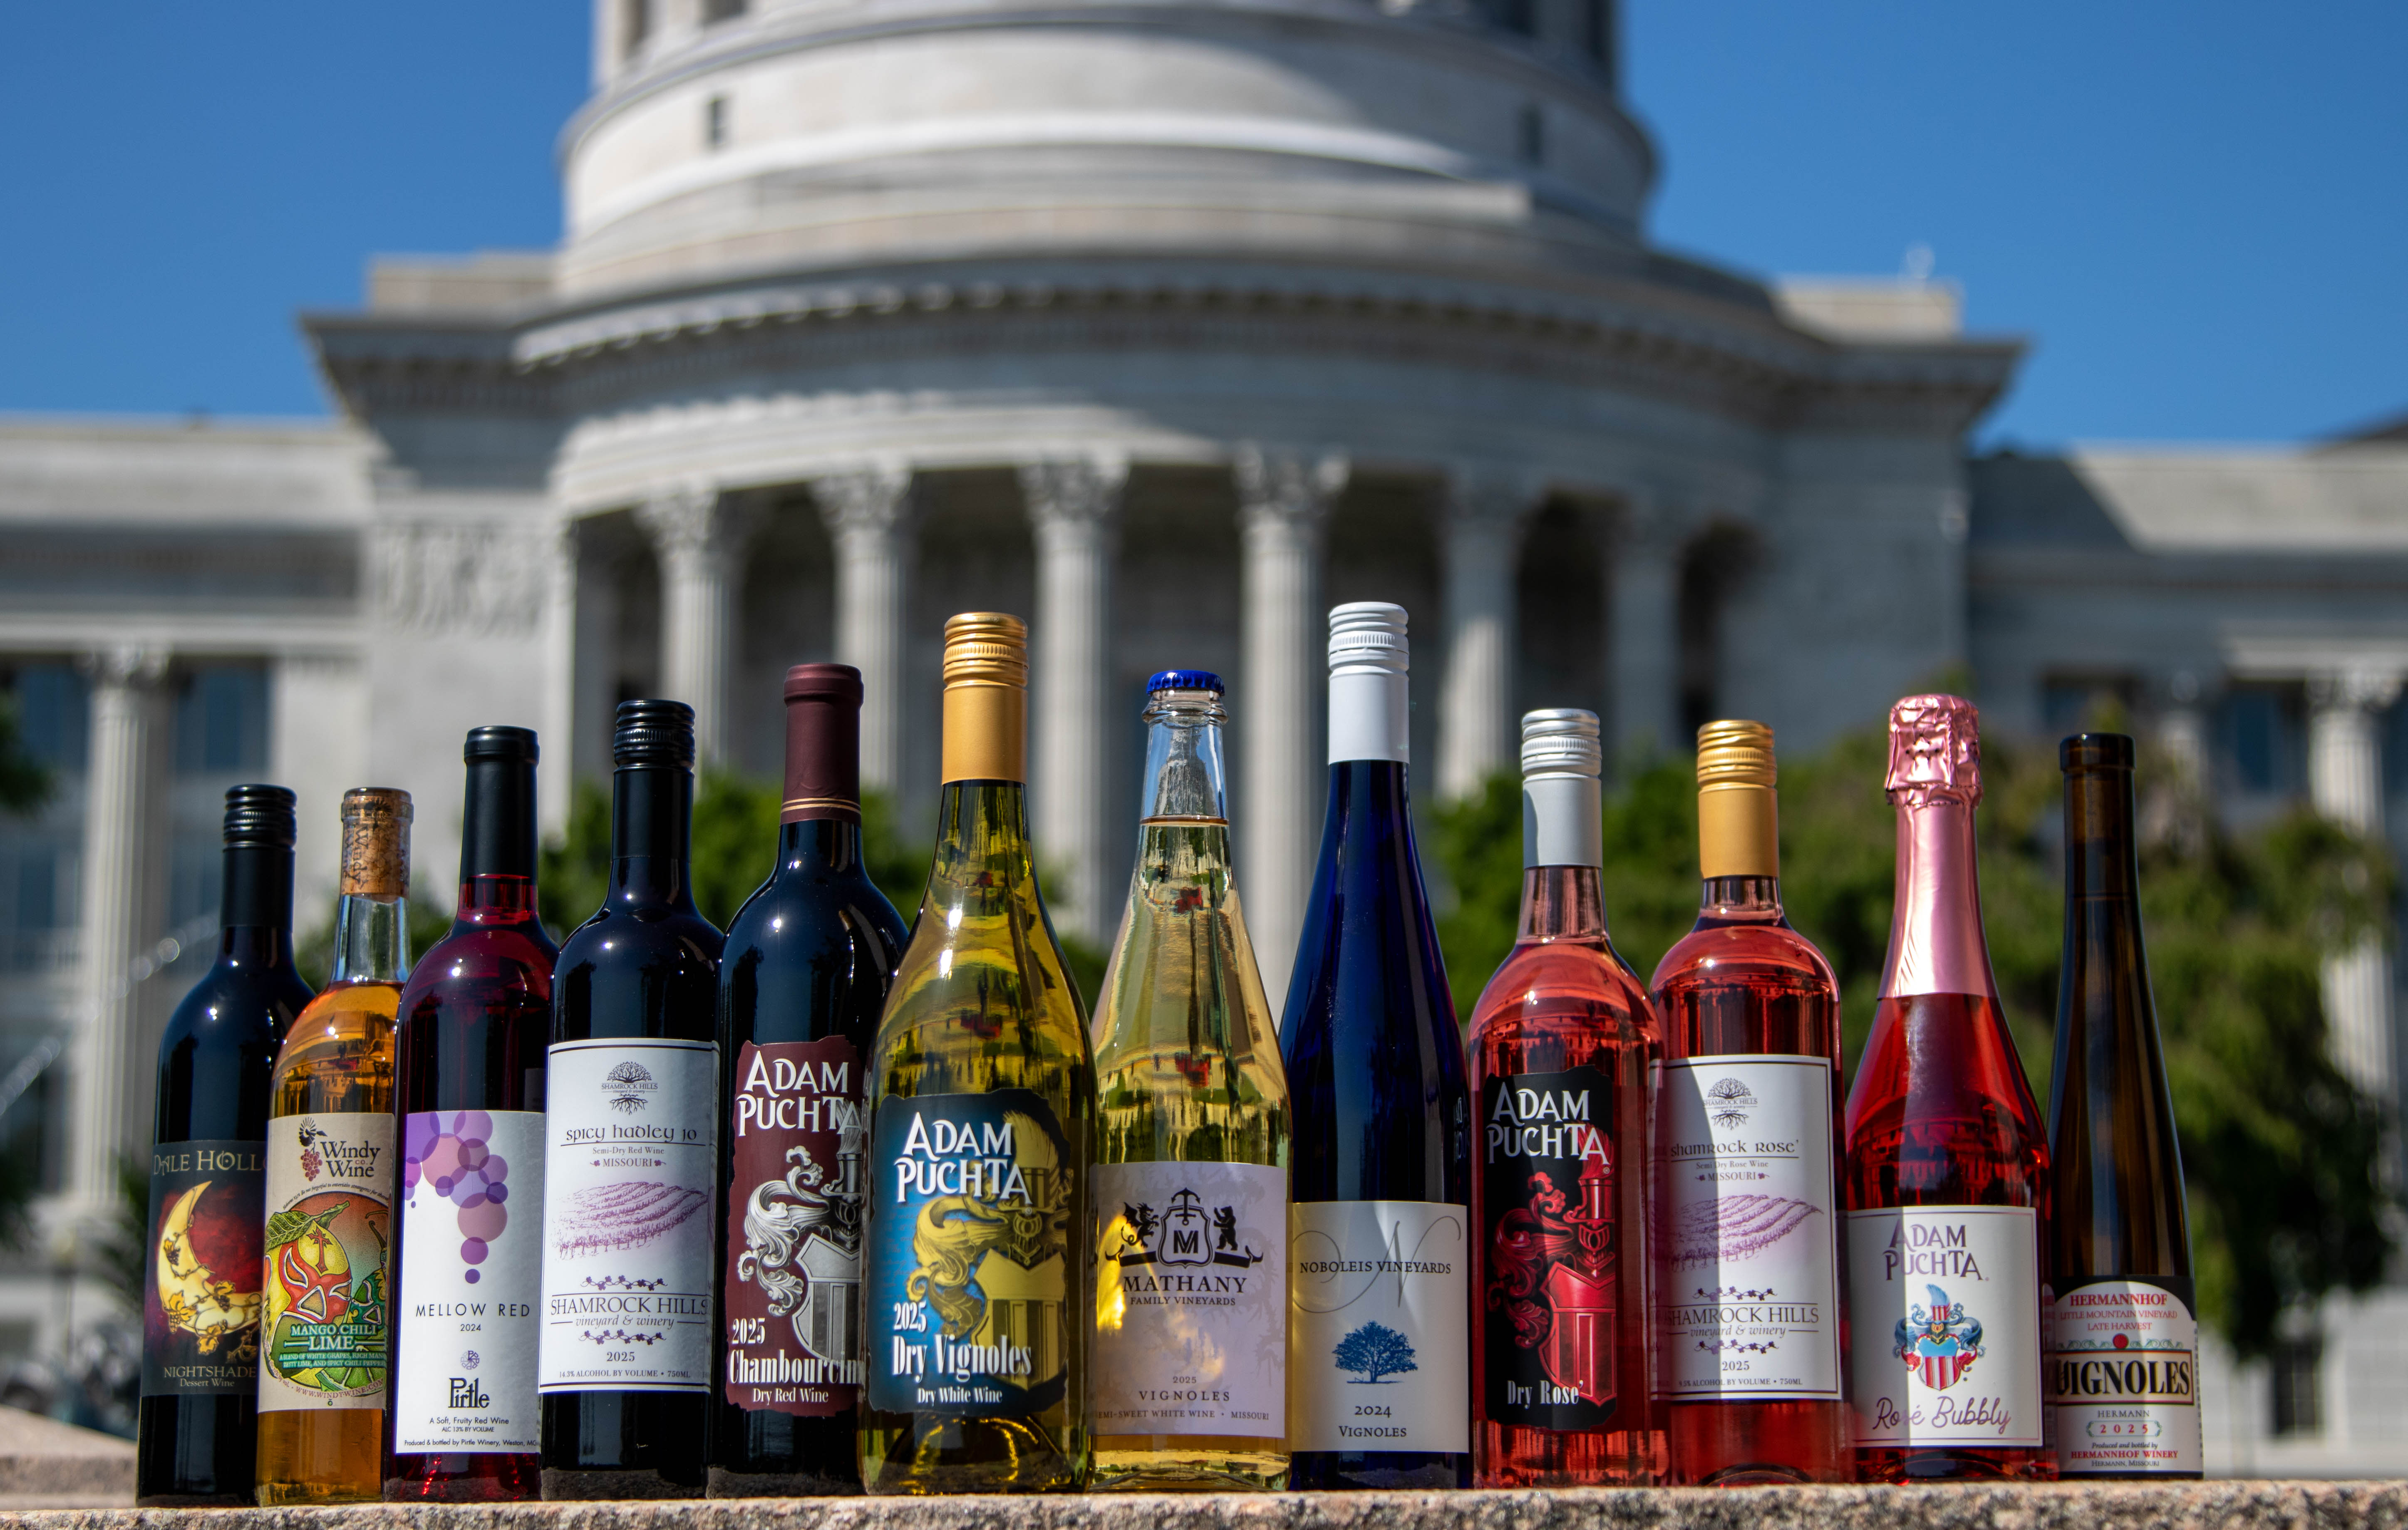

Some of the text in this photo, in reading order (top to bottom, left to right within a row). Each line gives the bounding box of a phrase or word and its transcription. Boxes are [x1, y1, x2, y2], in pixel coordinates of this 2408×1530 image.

[744, 1050, 849, 1098] ADAM
[1492, 1082, 1590, 1127] ADAM
[736, 1094, 863, 1136] PUCHTA
[566, 1128, 605, 1143] spicy
[613, 1124, 674, 1142] hadley
[903, 1112, 1012, 1161] ADAM
[320, 1140, 381, 1165] Windy
[593, 1146, 626, 1156] Semi-Dry
[645, 1146, 665, 1154] Wine
[1485, 1123, 1611, 1165] PUCHTA
[154, 1150, 266, 1176] DALE HOLL
[326, 1159, 374, 1177] Wine
[603, 1158, 652, 1167] MISSOURI
[1696, 1161, 1712, 1170] Semi
[1716, 1161, 1727, 1170] Dry
[894, 1157, 1033, 1205] PUCHTA
[1708, 1172, 1756, 1182] MISSOURI
[1173, 1230, 1199, 1254] M
[1889, 1218, 1967, 1253] ADAM
[1300, 1261, 1451, 1274] NOBOLEIS VINEYARDS
[1882, 1249, 1984, 1281] PUCHTA
[1123, 1275, 1247, 1293] MATHANY
[551, 1297, 706, 1315] SHAMROCK HILLS
[1131, 1297, 1236, 1305] FAMILY VINEYARDS
[2070, 1293, 2167, 1307] HERMANNHOF
[416, 1303, 530, 1317] MELLOW RED
[894, 1300, 927, 1332] 2025
[1666, 1307, 1819, 1326] SHAMROCK HILLS
[2060, 1310, 2177, 1321] LITTLE MOUNTAIN VINEYARD
[291, 1324, 377, 1336] MANGO CHILI
[576, 1315, 675, 1330] vineyard & winery
[732, 1318, 766, 1344] 2025
[2111, 1322, 2152, 1330] HARVEST
[1690, 1325, 1786, 1339] vineyard & winery
[309, 1336, 354, 1350] LIME
[606, 1352, 635, 1362] 2025
[893, 1333, 1032, 1383] Dry Vignoles
[1722, 1361, 1750, 1371] 2025
[164, 1366, 257, 1378] NIGHTSHADE
[730, 1349, 858, 1384] Chambourcin
[180, 1377, 235, 1386] Dessert Wine
[448, 1378, 490, 1408] Pirtle
[753, 1387, 829, 1405] Dry Red Wine
[918, 1386, 1003, 1406] Dry White Wine
[1138, 1391, 1230, 1401] VIGNOLES
[1507, 1380, 1533, 1410] Dry
[1098, 1410, 1149, 1419] EMI-SWEET
[1230, 1411, 1269, 1420] MISSOURI
[1354, 1405, 1392, 1418] 2024
[1872, 1396, 2011, 1435] Rosé Bubbly
[454, 1417, 472, 1426] Fruity
[452, 1439, 459, 1447] by
[2071, 1450, 2179, 1458] HERMANNHOF WINERY
